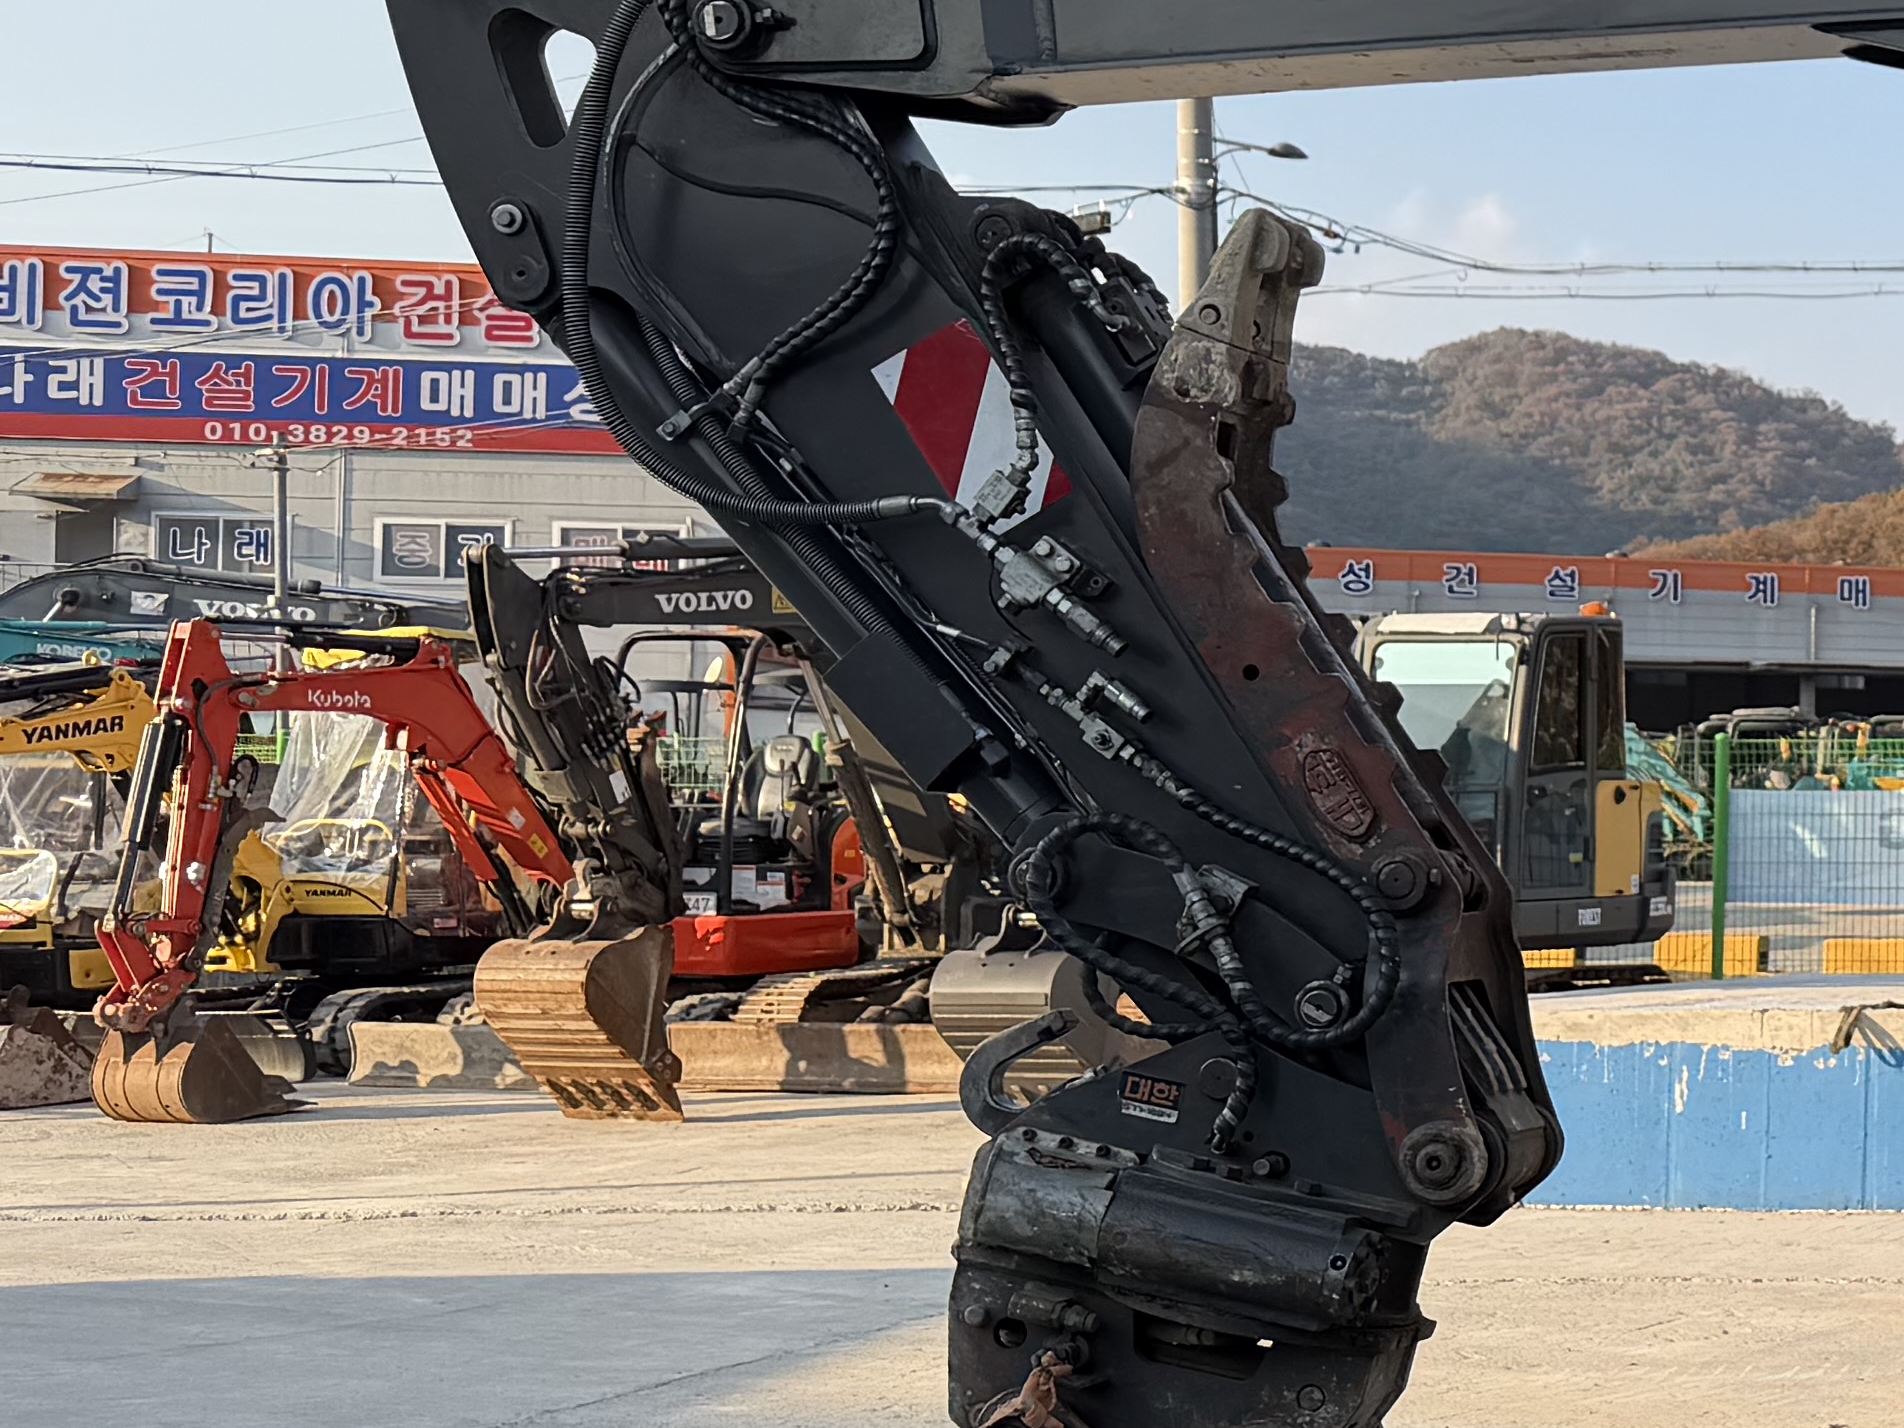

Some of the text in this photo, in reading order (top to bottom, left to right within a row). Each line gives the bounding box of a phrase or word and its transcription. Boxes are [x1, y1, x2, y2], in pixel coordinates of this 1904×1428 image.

[654, 589, 754, 614] VOLVO
[307, 688, 372, 710] Kubota
[22, 714, 125, 745] YANMAR
[1123, 1075, 1180, 1107] 대한
